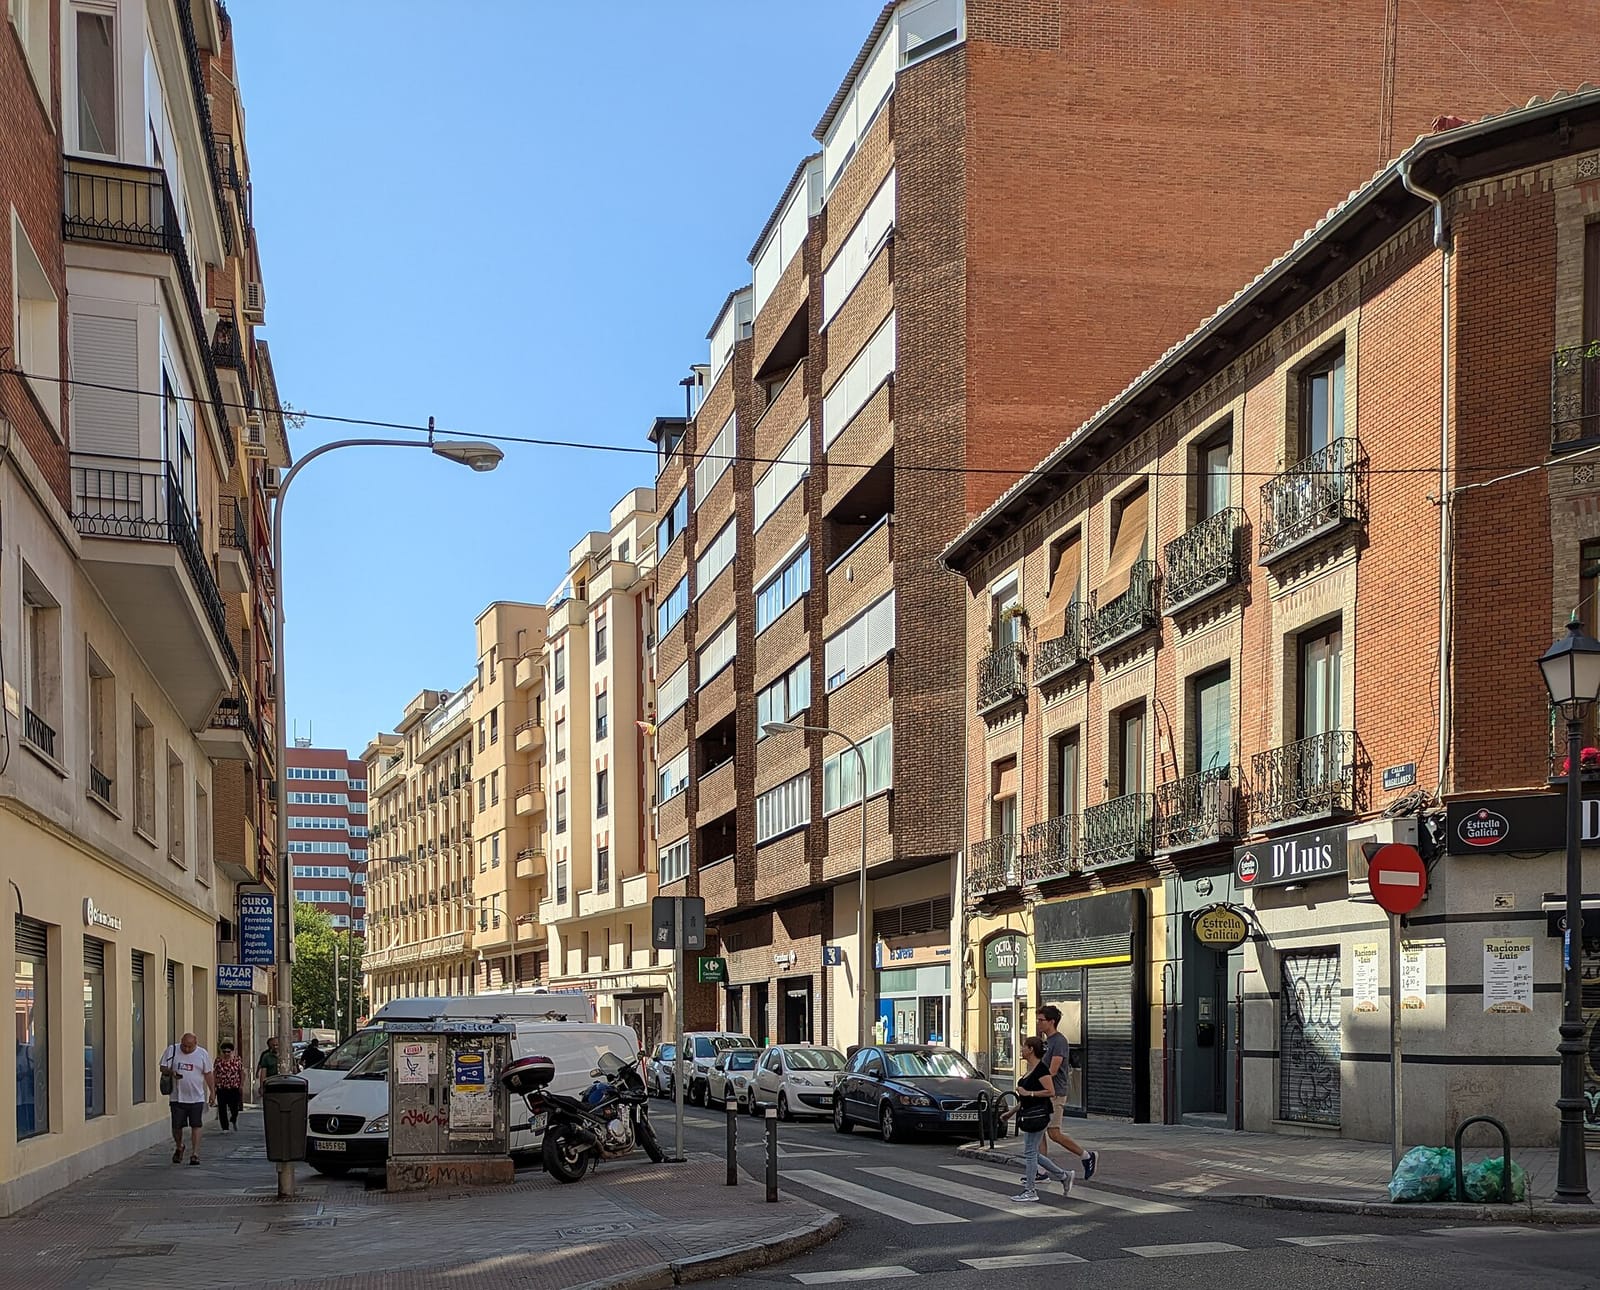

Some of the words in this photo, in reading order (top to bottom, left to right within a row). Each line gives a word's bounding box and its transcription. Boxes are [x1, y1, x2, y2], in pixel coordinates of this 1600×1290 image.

[1391, 766, 1405, 774] CALLE
[1385, 774, 1412, 788] MAGALLANES
[1466, 819, 1500, 829] Estrella
[1467, 828, 1499, 838] Galicia
[1272, 836, 1332, 878] D'Luis
[241, 906, 273, 915] BAZAR
[244, 924, 271, 932] Limpieza
[1202, 918, 1241, 929] Estrella
[244, 932, 265, 940] Regalo
[1203, 929, 1240, 940] Galicia
[1354, 949, 1377, 957] Raciones
[1486, 944, 1531, 953] Raciones
[1498, 952, 1519, 960] Luis
[219, 966, 252, 978] BAZAR
[219, 978, 252, 988] Magallanes
[993, 1022, 1010, 1032] TATTOO
